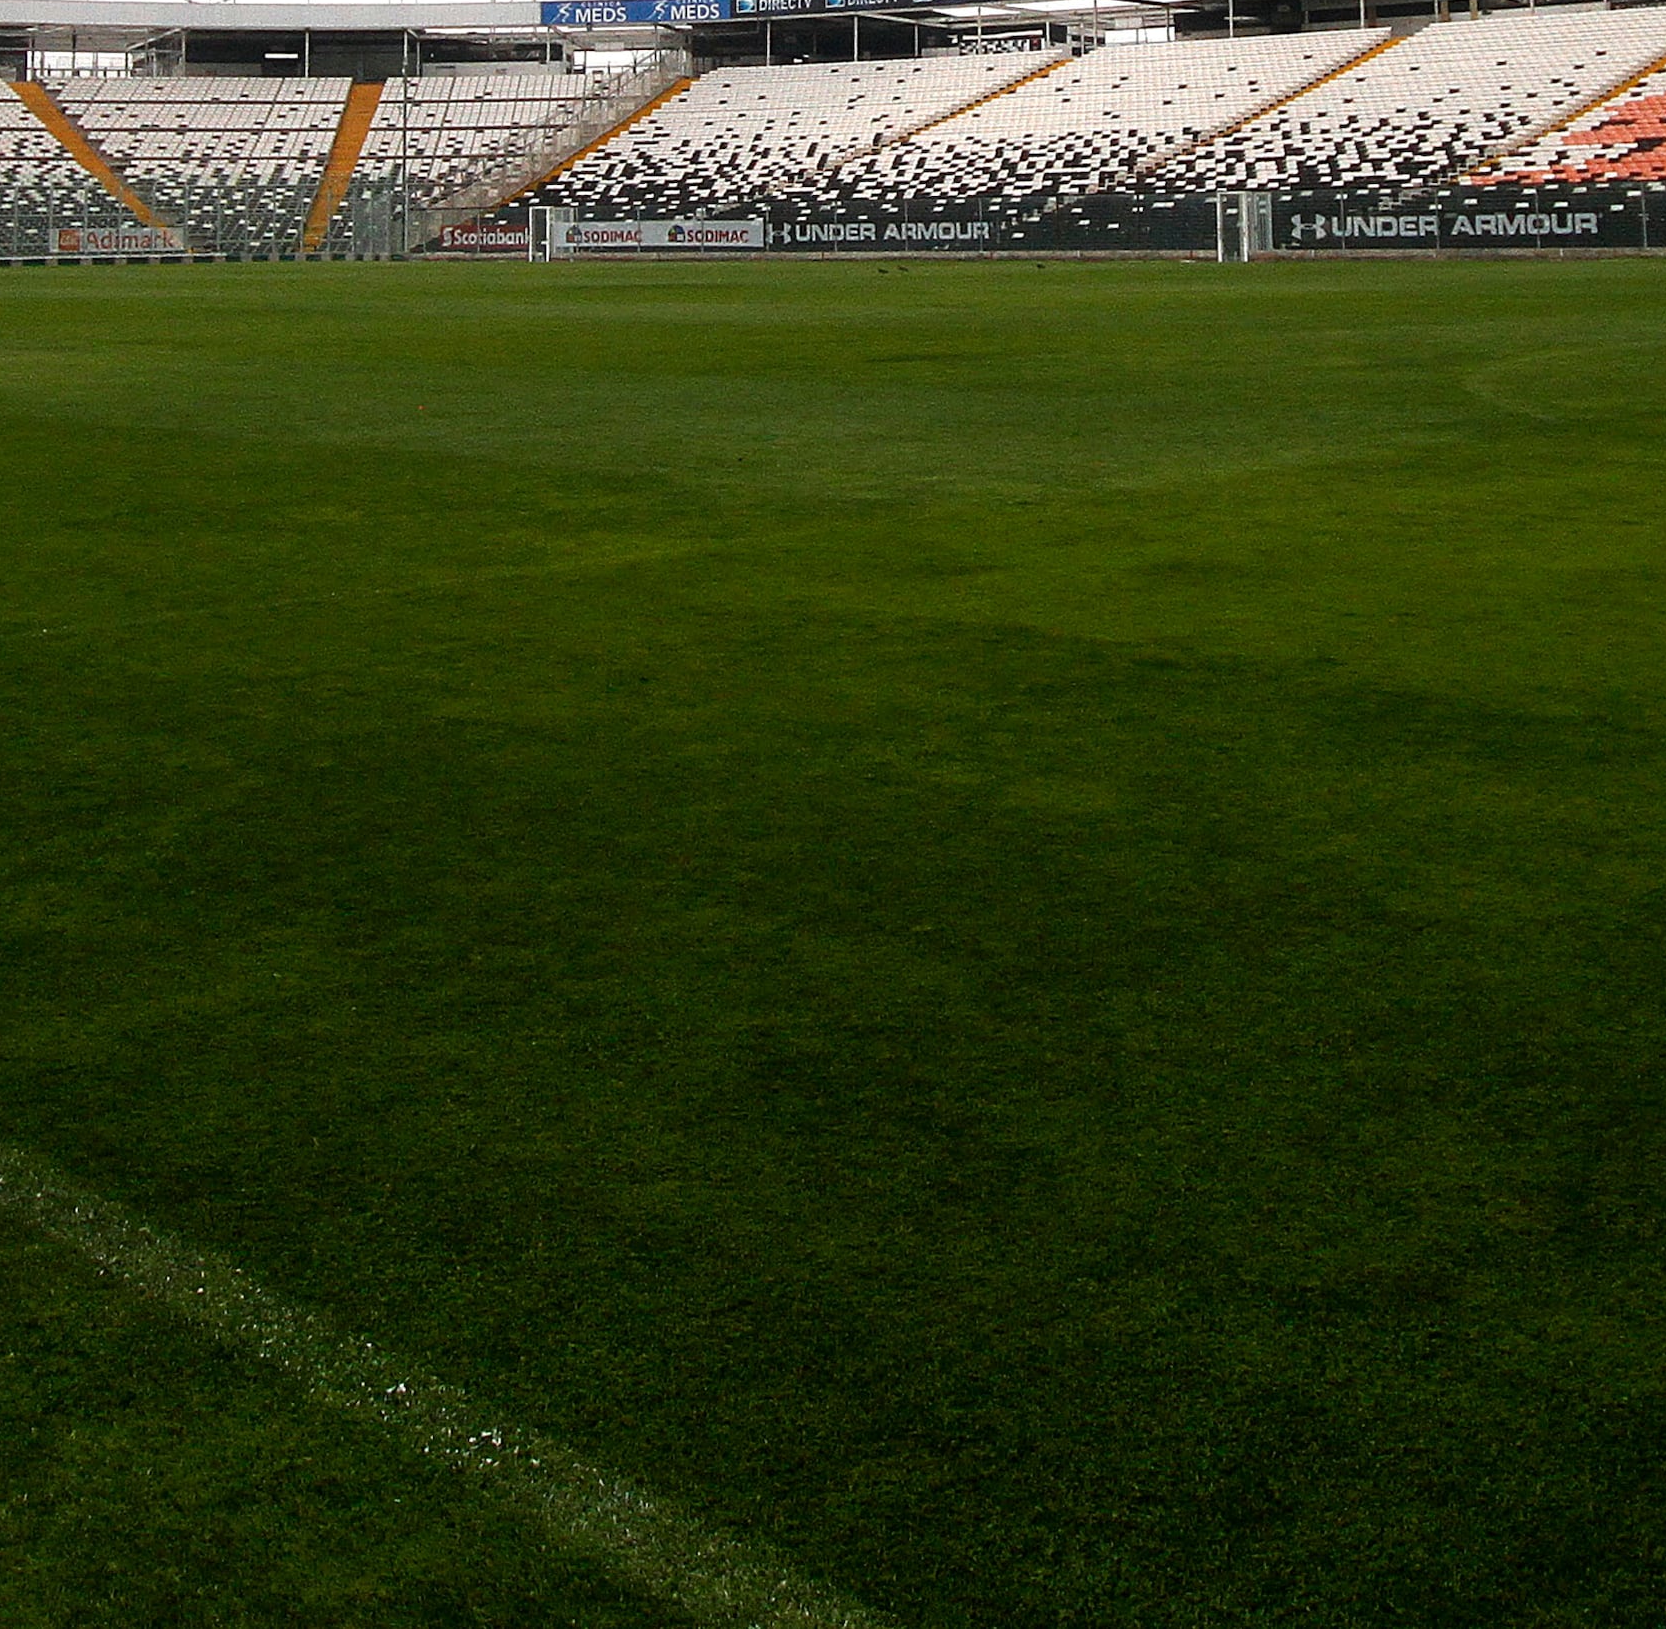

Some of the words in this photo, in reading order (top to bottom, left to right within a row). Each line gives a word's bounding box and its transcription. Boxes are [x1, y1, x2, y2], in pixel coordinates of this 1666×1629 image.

[575, 7, 627, 23] MEDS
[671, 4, 720, 20] MEDS
[795, 223, 877, 242] UNDER
[883, 221, 990, 240] ARMOUR
[1332, 215, 1437, 237] UNDER
[1450, 212, 1599, 235] ARMOUR
[86, 230, 174, 250] Adimark
[453, 227, 530, 246] Scotiabank
[583, 230, 643, 244] SODIMAC
[687, 229, 749, 244] SODIMAC
